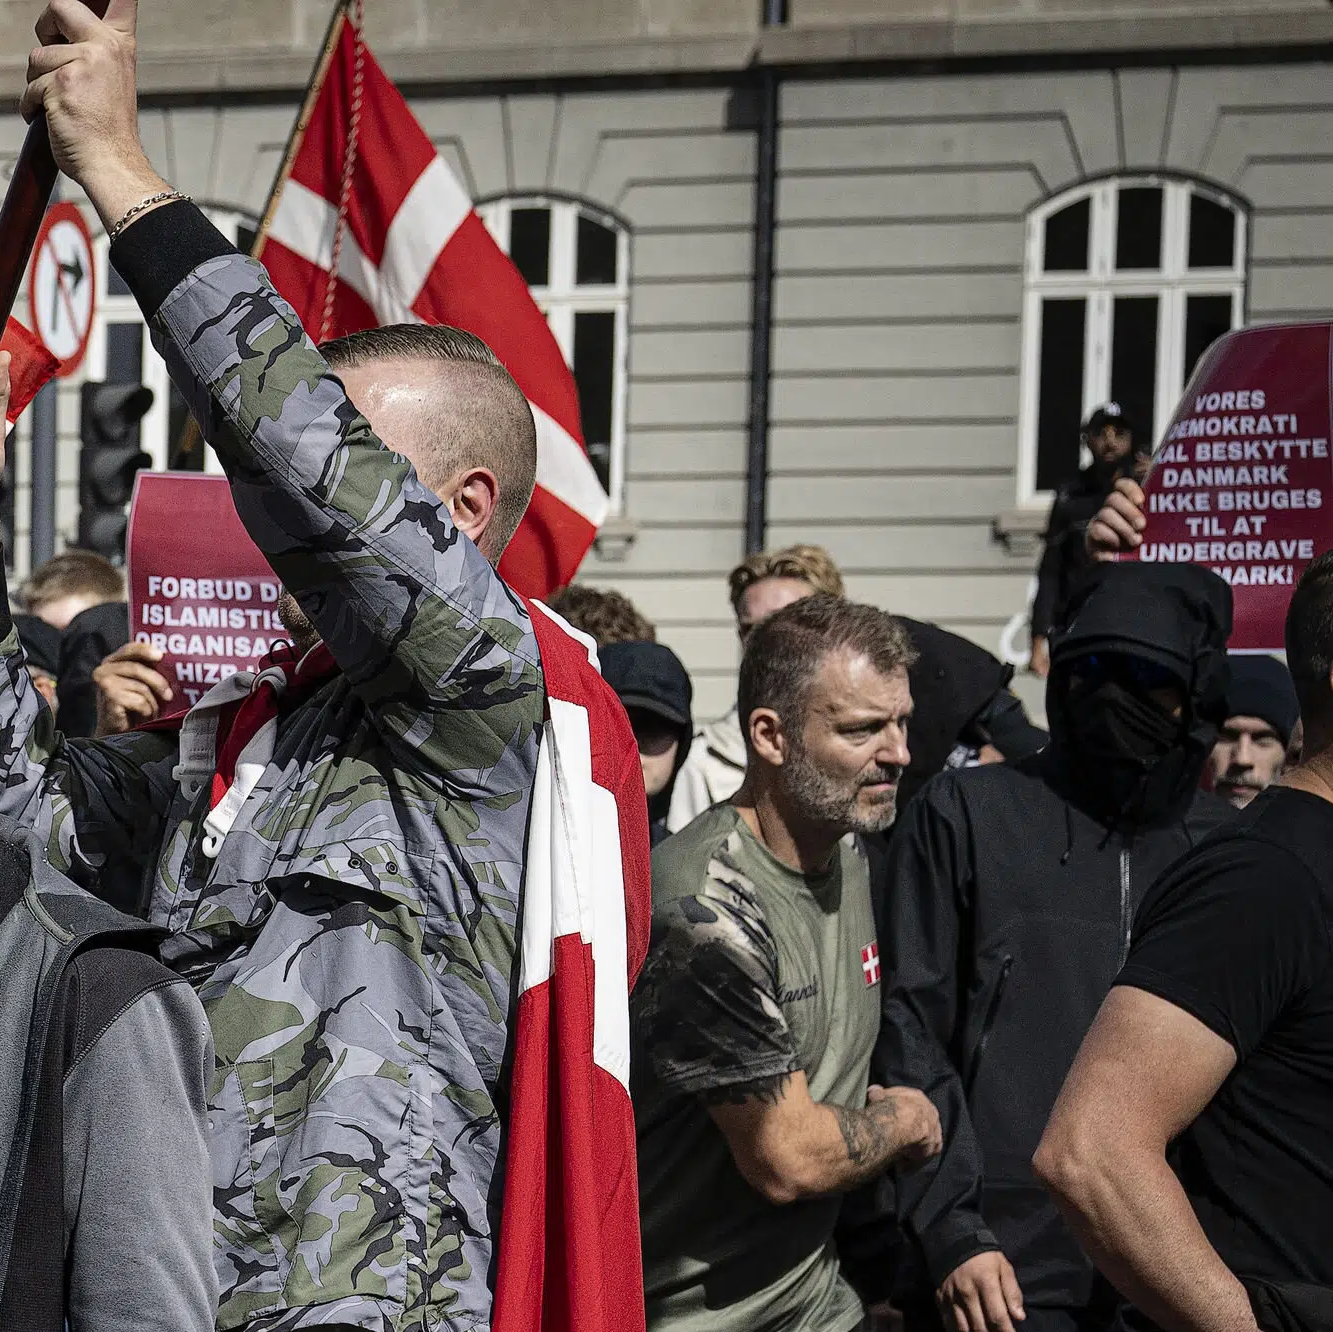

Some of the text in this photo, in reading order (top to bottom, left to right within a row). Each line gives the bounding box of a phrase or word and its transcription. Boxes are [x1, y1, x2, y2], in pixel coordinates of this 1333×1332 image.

[1195, 389, 1266, 413] VORES
[1195, 438, 1329, 462] BESKYTTE
[1162, 465, 1289, 488] DANMARK
[1149, 488, 1323, 513] IKKE BRUGES
[1185, 515, 1267, 537] TIL AT
[1139, 539, 1315, 562] UNDERGRAVE
[1211, 564, 1294, 585] MARK!
[148, 576, 252, 601] FORBUD
[142, 603, 285, 631] ISLAMISTIS
